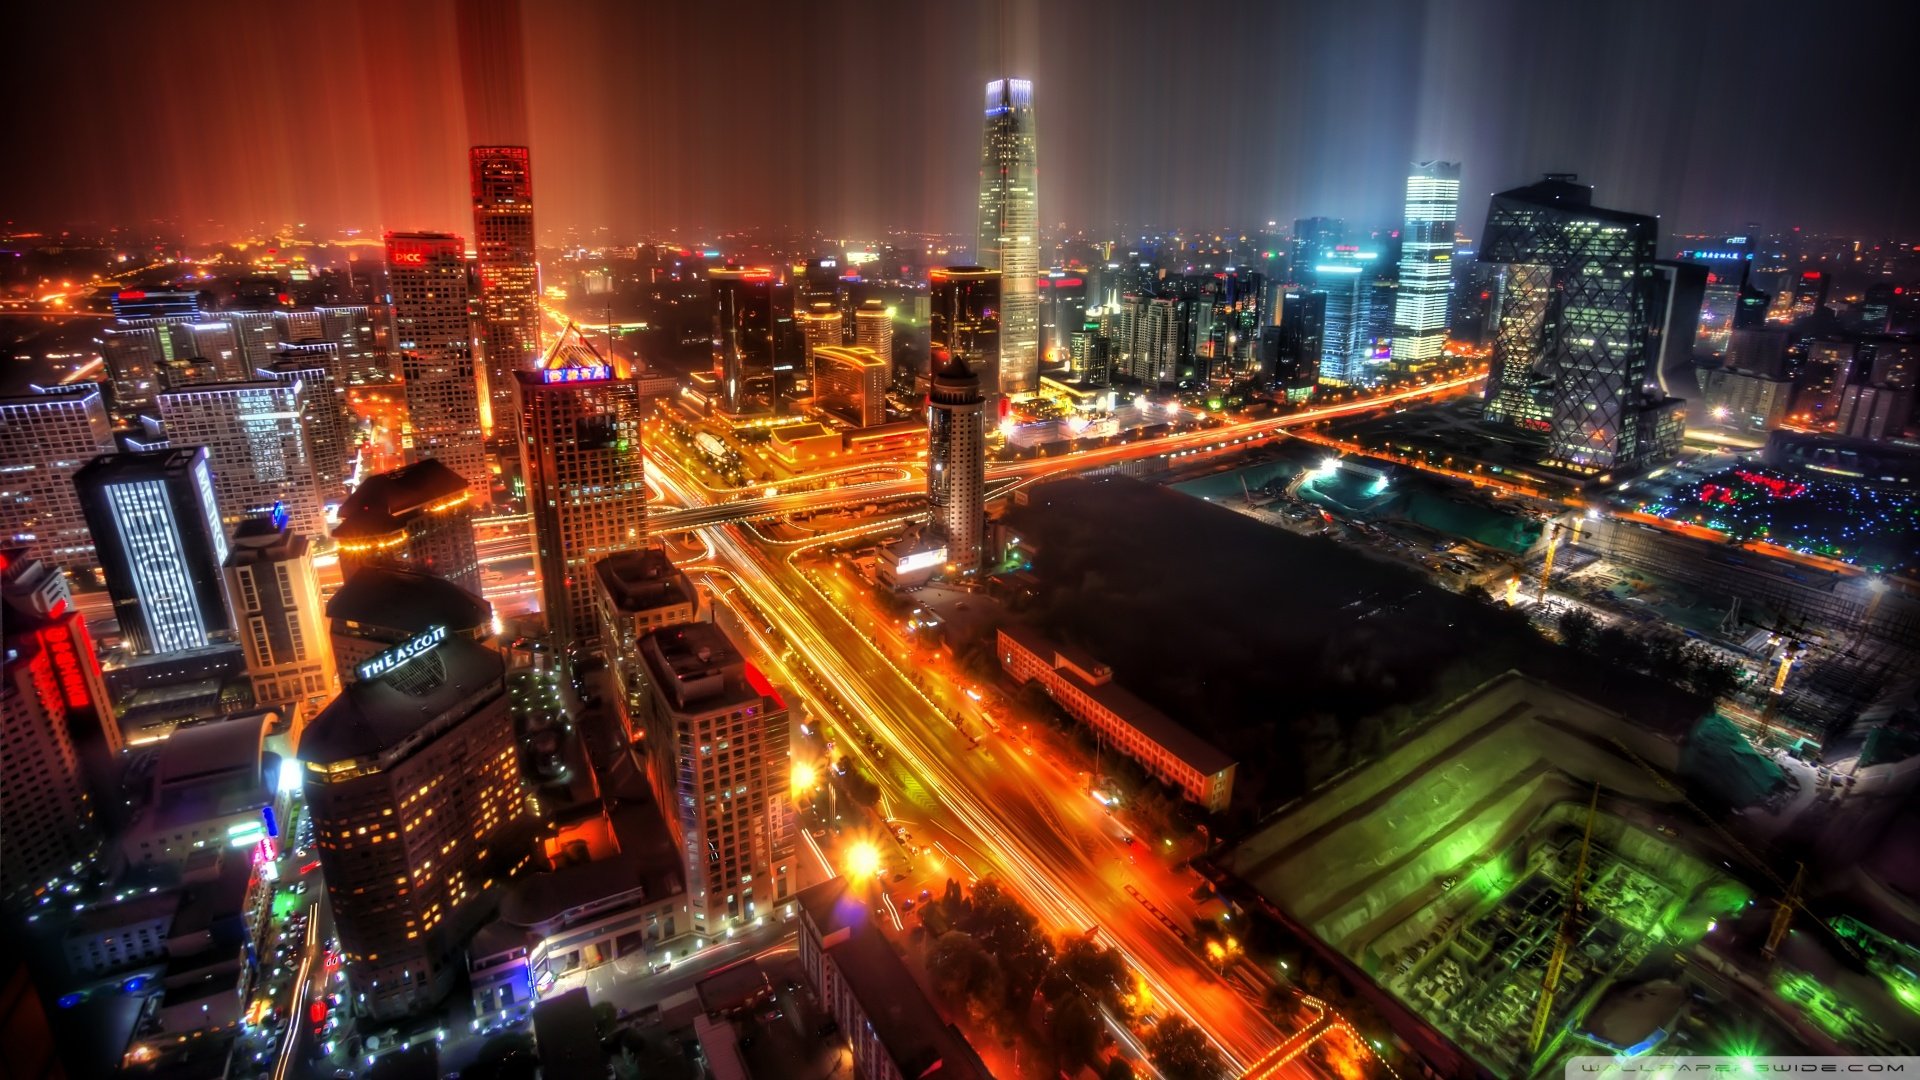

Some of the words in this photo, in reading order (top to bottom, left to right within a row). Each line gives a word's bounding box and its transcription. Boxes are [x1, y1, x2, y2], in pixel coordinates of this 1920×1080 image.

[395, 253, 421, 262] PICC
[116, 486, 202, 647] METROPOLIS
[362, 655, 395, 678] THE
[397, 626, 445, 662] ASCOTT
